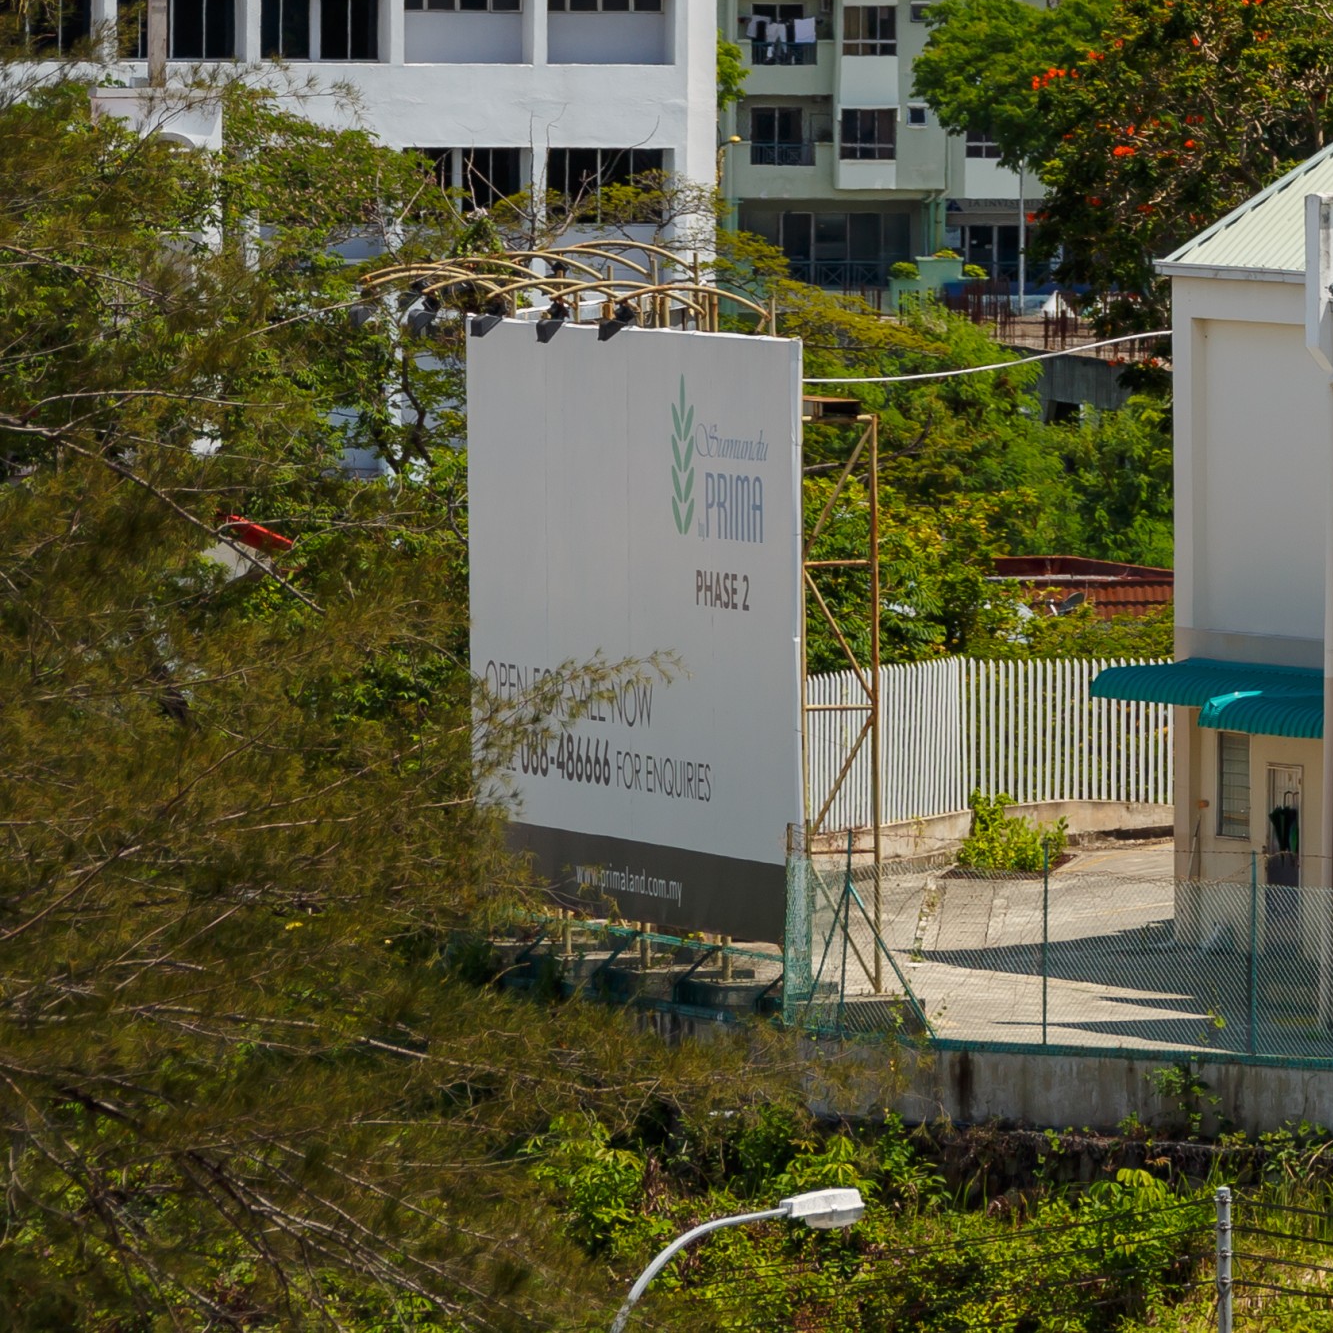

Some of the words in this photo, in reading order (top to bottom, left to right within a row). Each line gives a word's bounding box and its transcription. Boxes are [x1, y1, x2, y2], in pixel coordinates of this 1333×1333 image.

[705, 472, 763, 544] PRIMA
[696, 570, 738, 610] PHASE
[742, 574, 750, 612] 2
[486, 660, 527, 709] OPEN
[611, 678, 653, 728] NOW
[520, 728, 611, 787] 088-486666
[616, 751, 642, 791] FOR
[646, 756, 711, 802] ENQUIRIES
[576, 863, 682, 907] www.primaland.com.my
